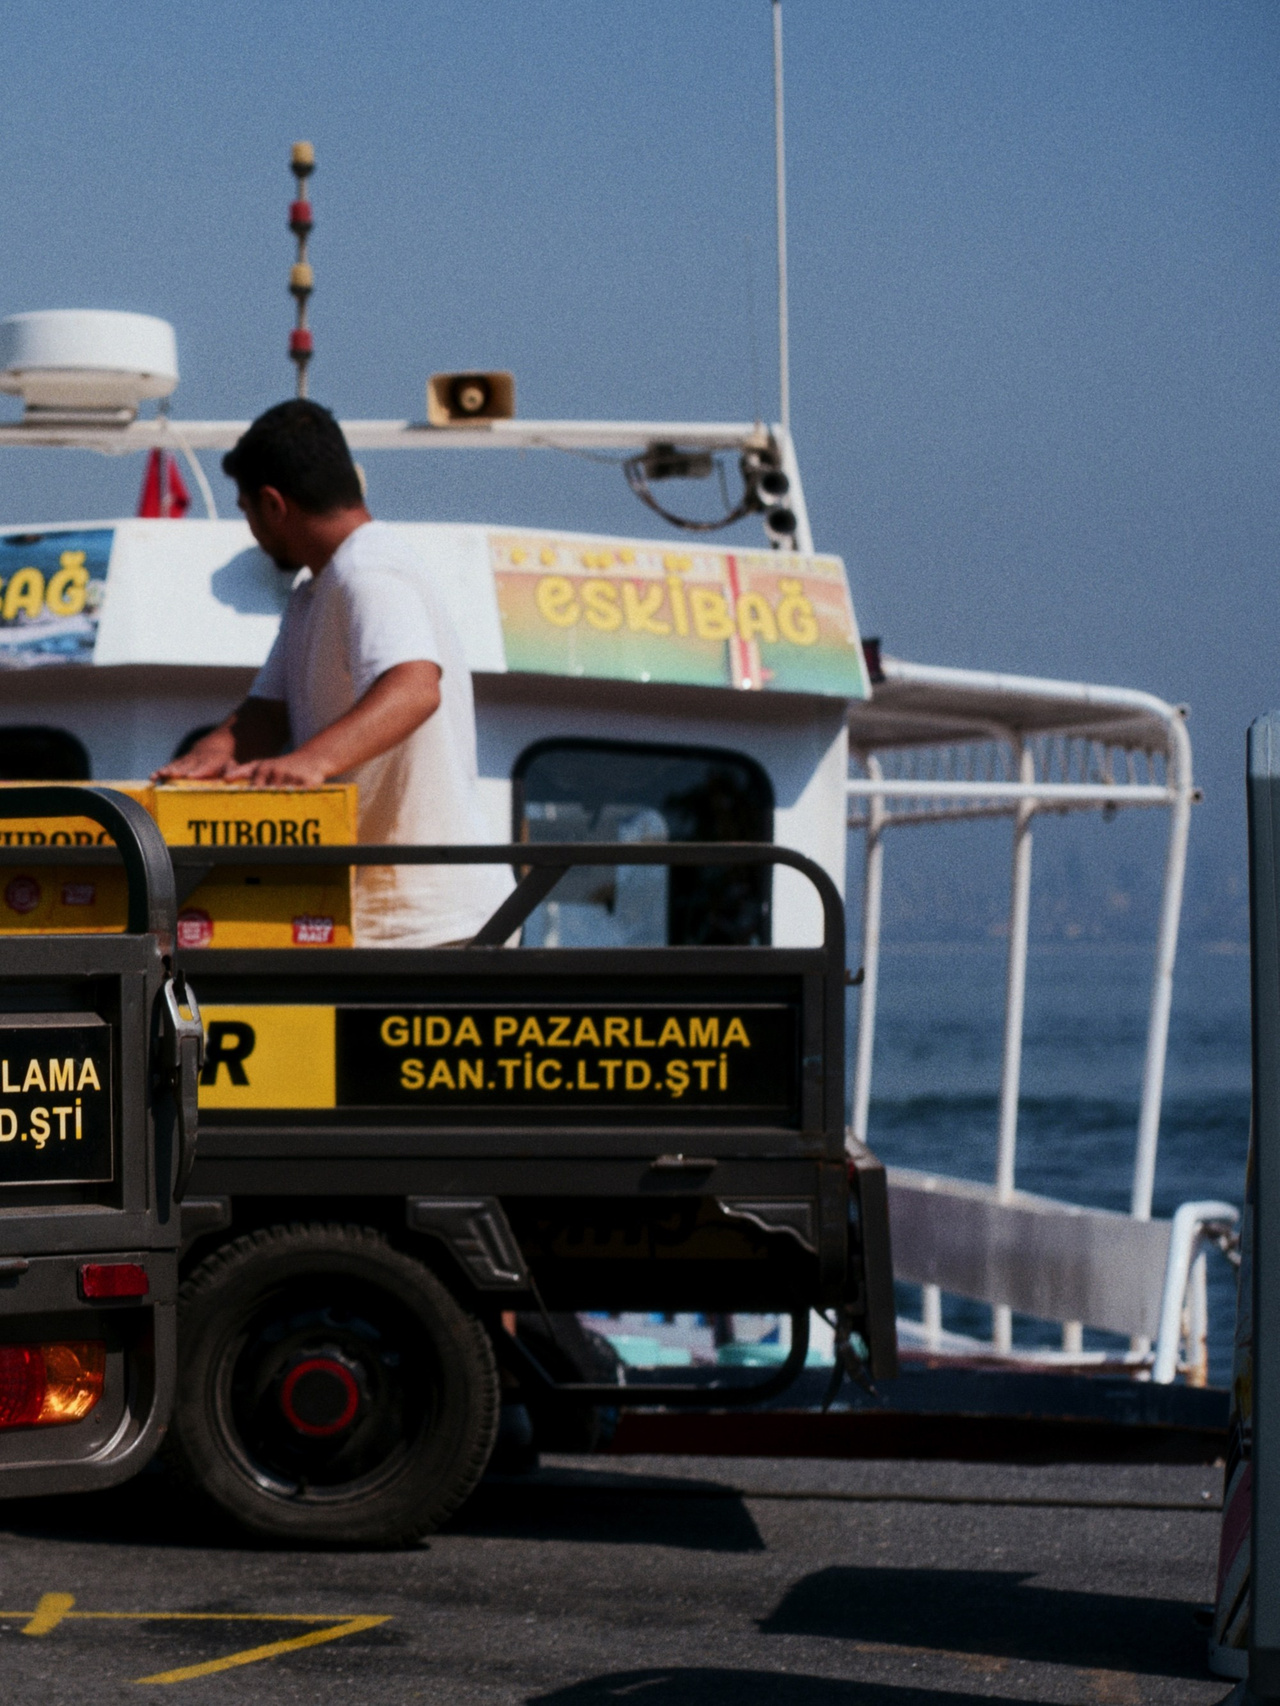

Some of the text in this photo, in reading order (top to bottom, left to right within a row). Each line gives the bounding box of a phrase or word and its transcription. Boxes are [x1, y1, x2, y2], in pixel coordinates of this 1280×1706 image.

[187, 819, 320, 846] TUBORG
[380, 1016, 751, 1049] GIDA PAZARLAMA
[400, 1052, 728, 1098] SAN.TİC.LTD.ŞTİ
